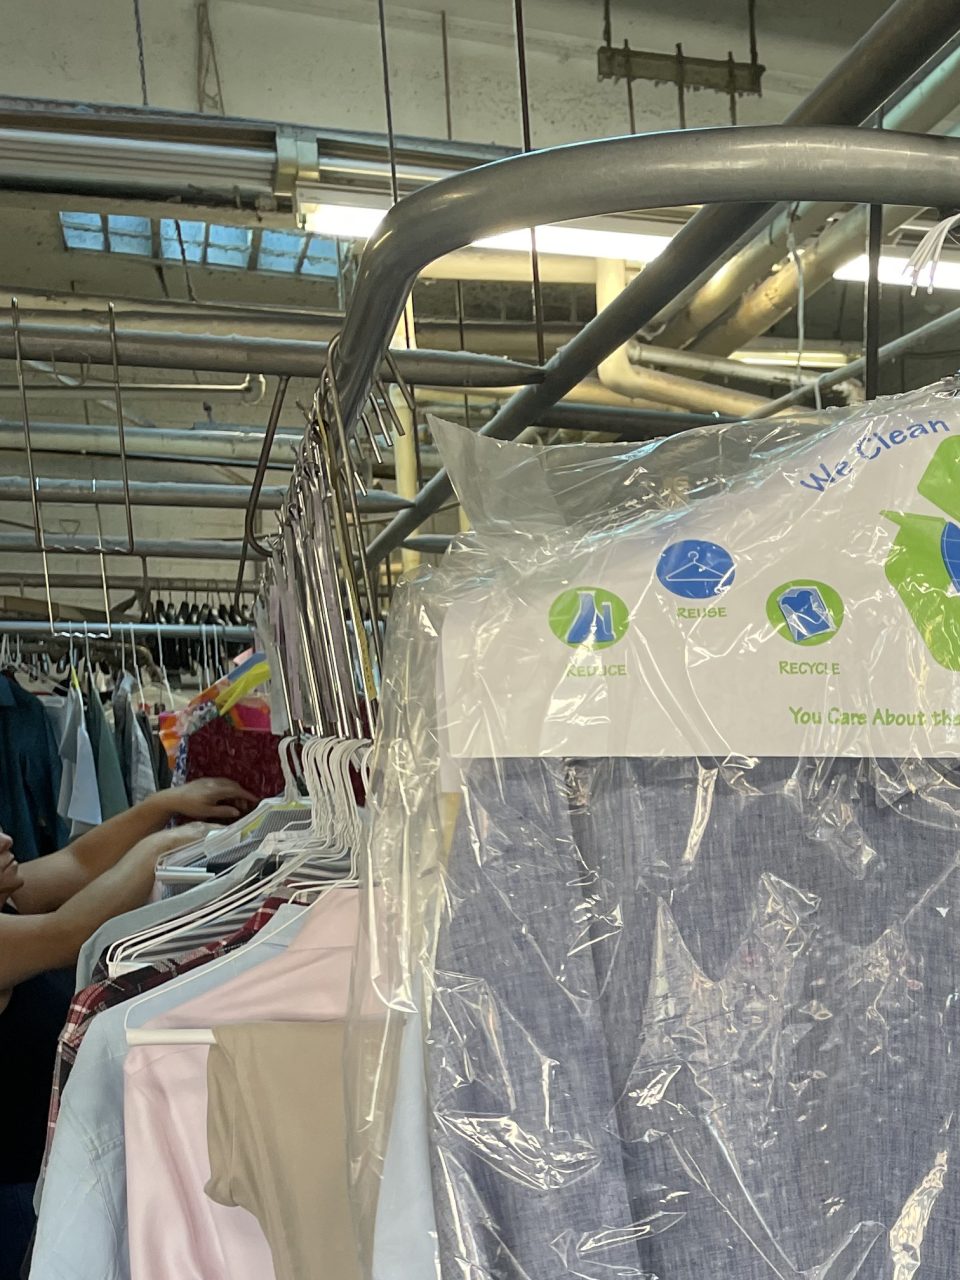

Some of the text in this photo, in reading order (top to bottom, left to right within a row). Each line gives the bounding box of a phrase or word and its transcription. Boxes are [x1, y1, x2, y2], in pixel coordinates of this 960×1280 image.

[801, 460, 854, 495] We
[856, 415, 950, 462] Clean
[676, 605, 727, 620] REUSE
[779, 660, 840, 676] RECYCLE
[789, 707, 822, 726] You
[827, 707, 867, 727] Care
[872, 708, 923, 726] About
